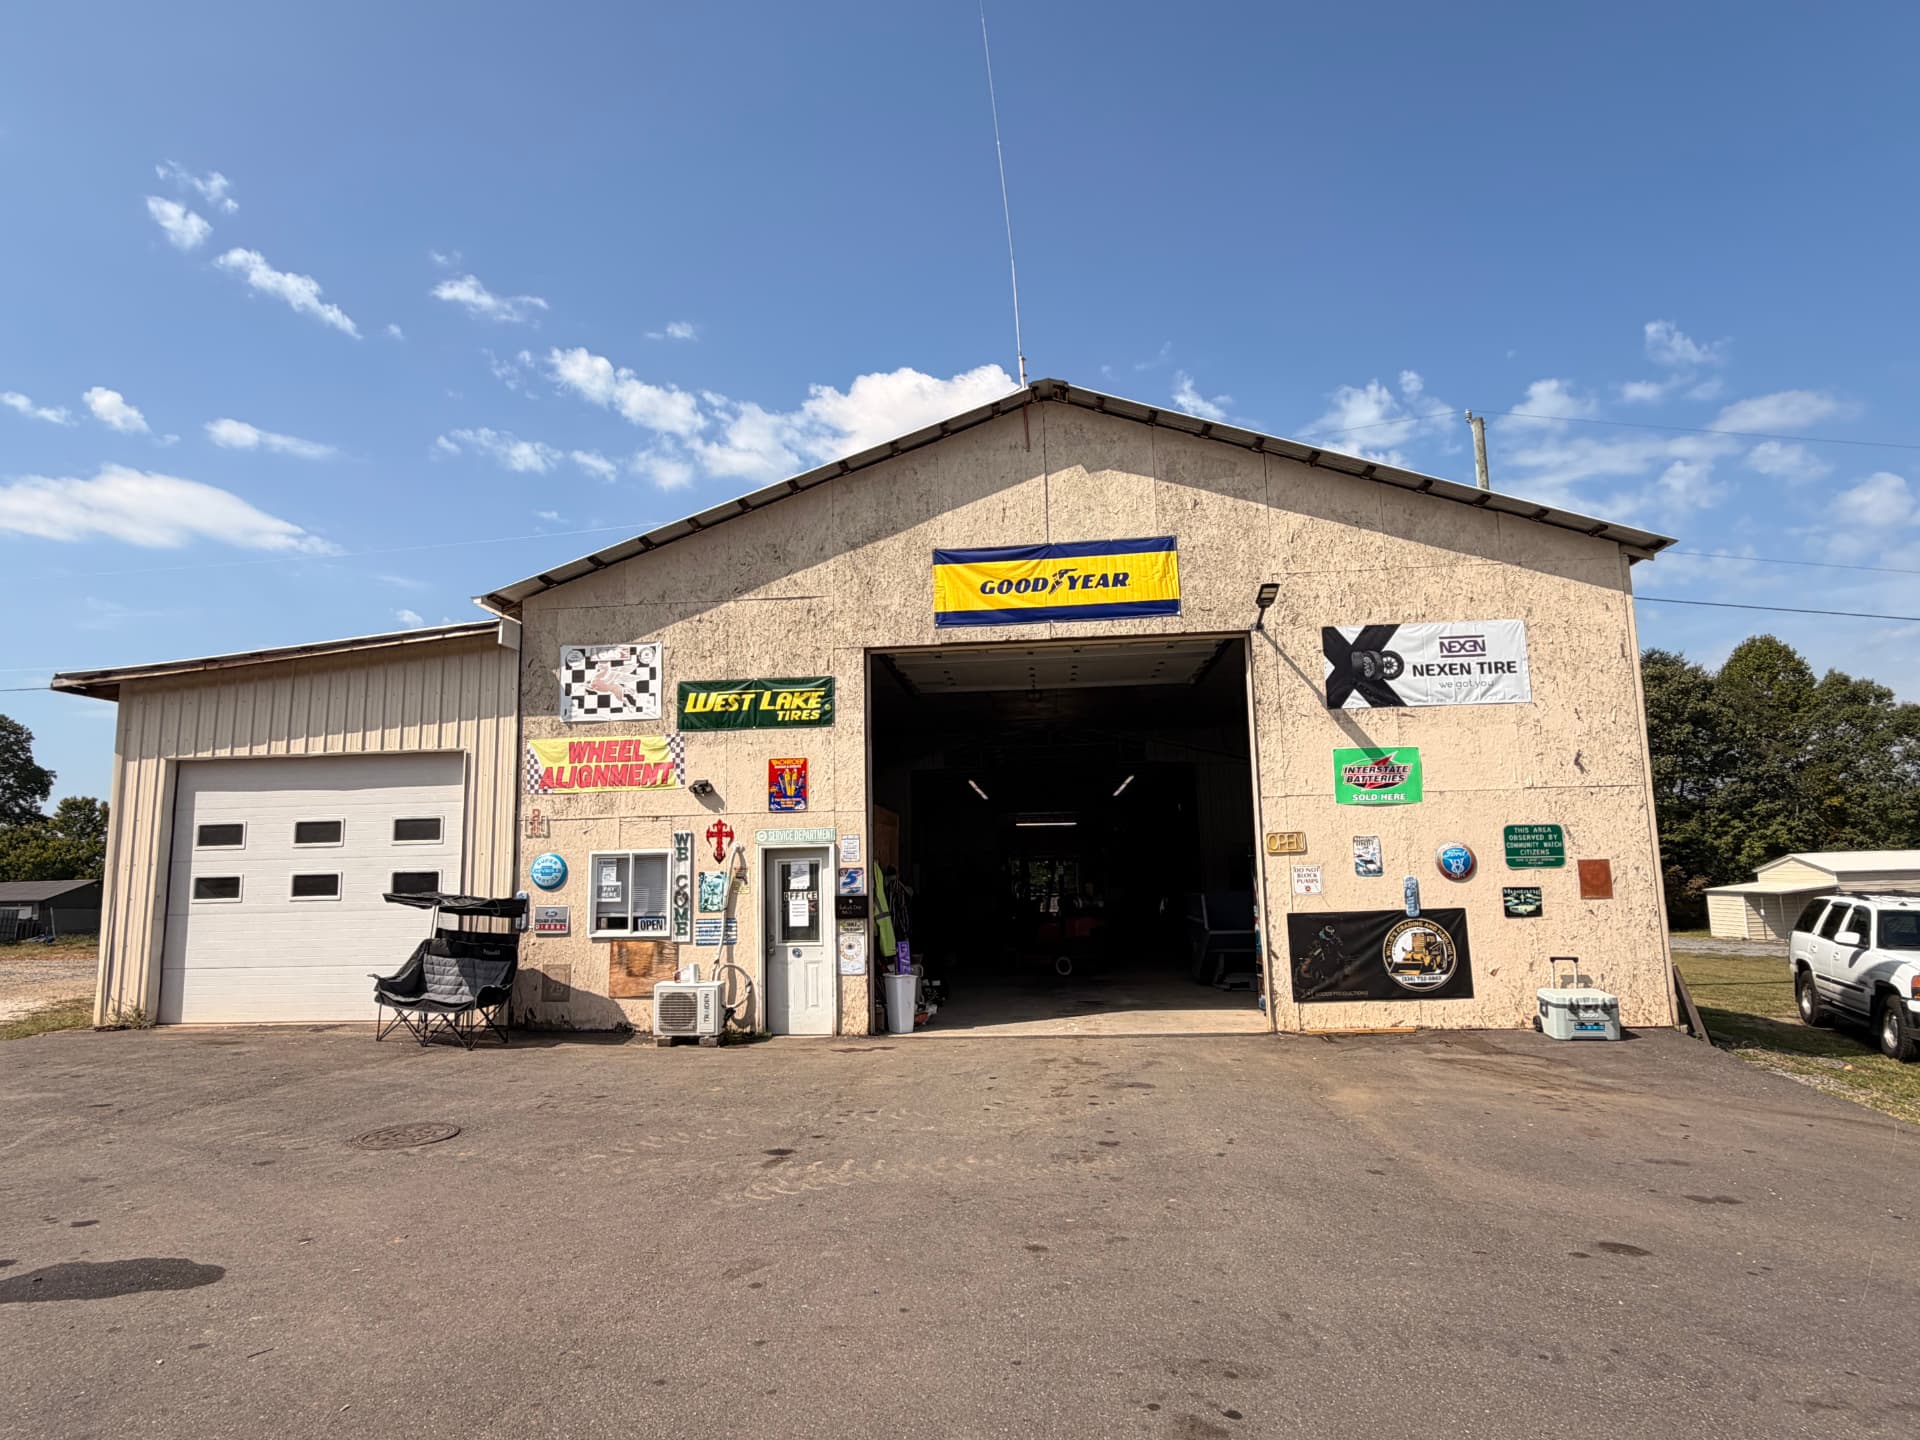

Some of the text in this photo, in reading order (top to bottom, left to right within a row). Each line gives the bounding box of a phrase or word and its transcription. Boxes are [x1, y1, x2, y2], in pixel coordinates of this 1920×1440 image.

[1412, 661, 1518, 677] NEXEN TIRE
[1457, 679, 1473, 690] got
[684, 688, 826, 713] WEST LAKE
[777, 710, 821, 721] TIRES
[568, 739, 645, 764] WHEEL
[539, 761, 675, 789] ALIGNMENT
[1343, 765, 1409, 774] INTERSTATE
[1346, 774, 1405, 783] BATTERIES
[768, 829, 835, 841] SERVICE DEPARTMENT
[1268, 833, 1304, 851] OPEN
[842, 870, 861, 887] 5
[783, 891, 817, 901] OFFICE
[640, 919, 663, 931] OPEN
